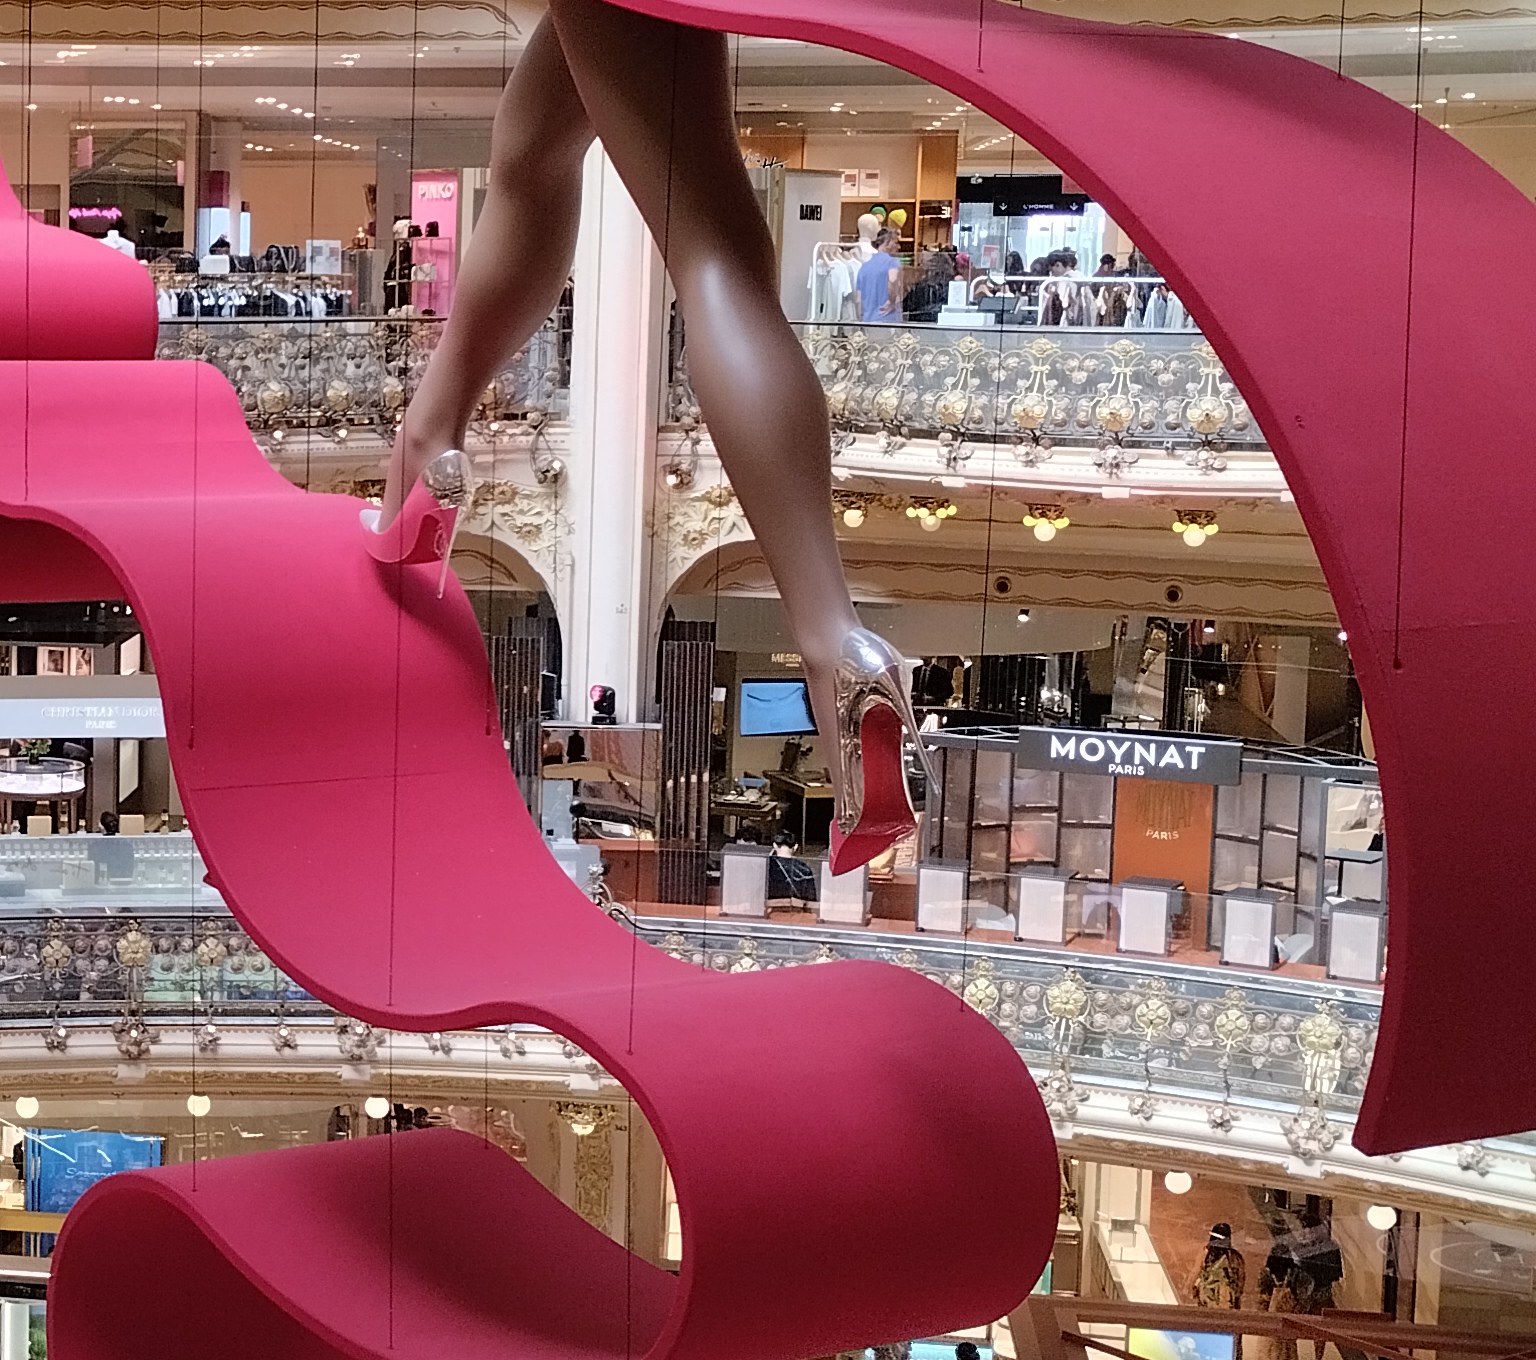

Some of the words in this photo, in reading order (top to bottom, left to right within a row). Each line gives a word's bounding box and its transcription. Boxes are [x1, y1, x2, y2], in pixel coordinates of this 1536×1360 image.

[418, 183, 455, 199] PINKO
[1050, 735, 1206, 770] MOYNAT
[1108, 764, 1144, 776] PARIS
[1145, 829, 1180, 840] PARIS
